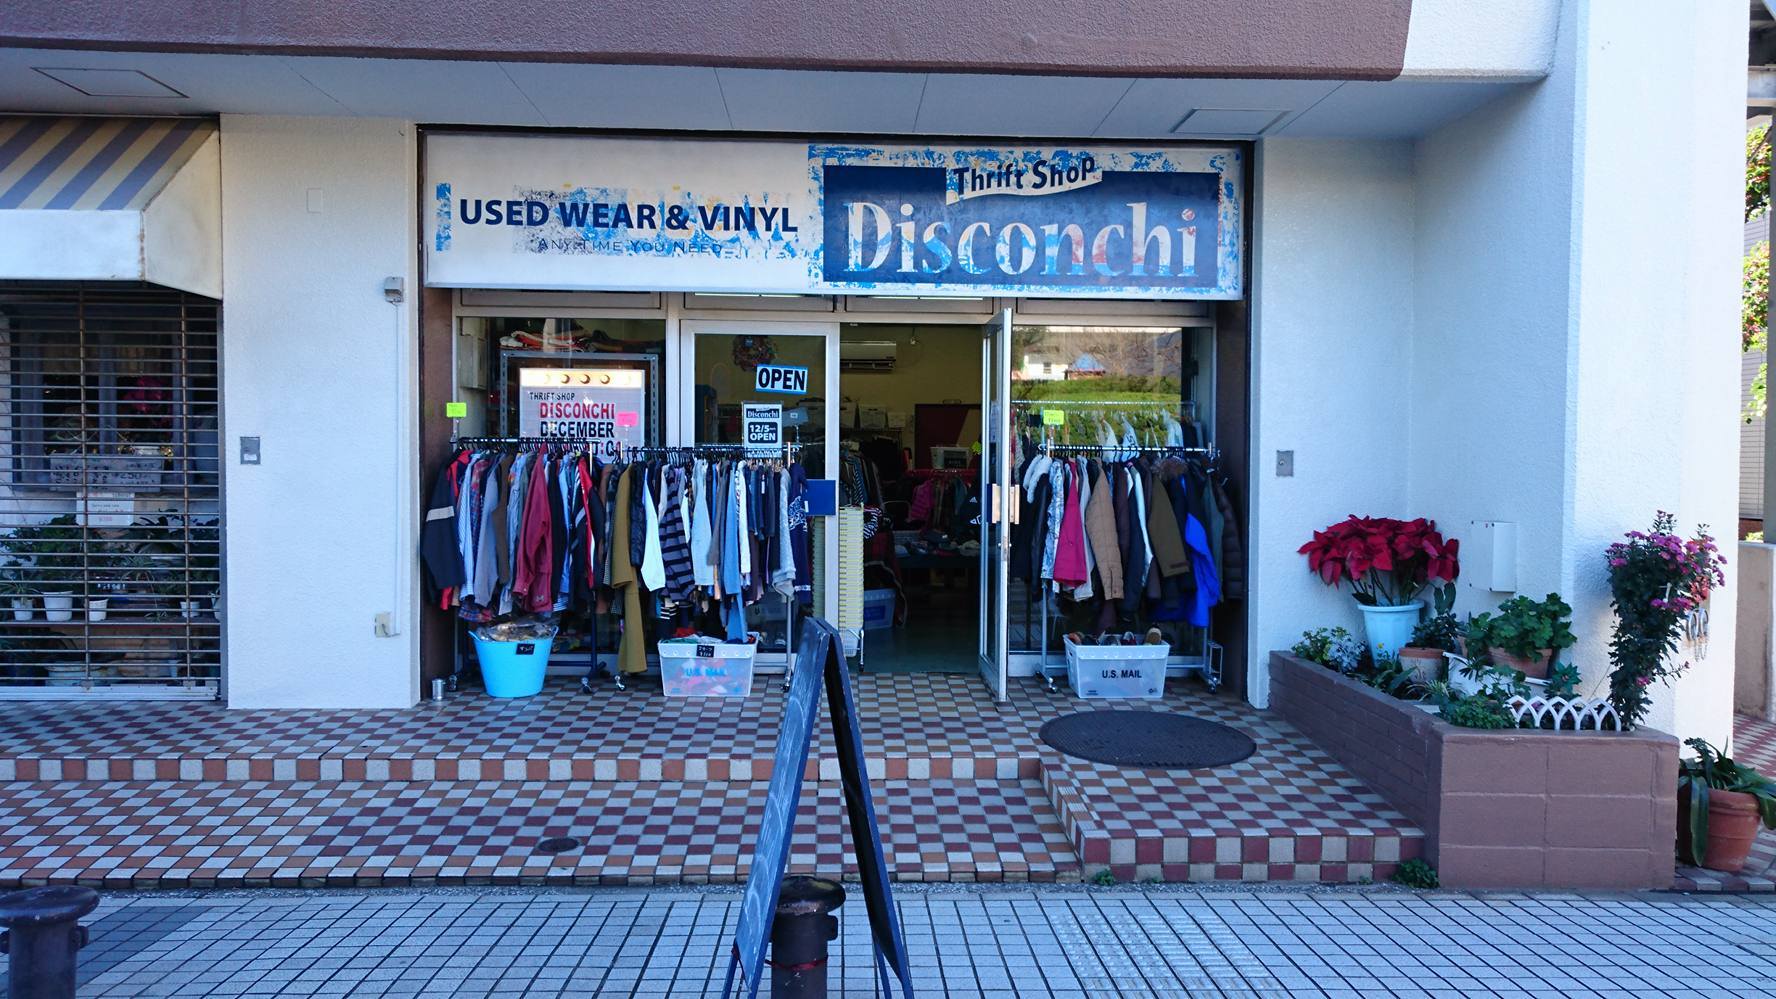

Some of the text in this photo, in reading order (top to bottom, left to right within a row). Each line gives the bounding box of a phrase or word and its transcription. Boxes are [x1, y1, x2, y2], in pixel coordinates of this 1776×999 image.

[953, 156, 1095, 196] Thrift Shop
[459, 198, 799, 233] USED WEAR & VINYL
[538, 237, 722, 255] ANY TIME YOU NEED
[842, 201, 1199, 278] Disconchi
[758, 368, 805, 391] OPEN
[529, 392, 575, 401] THRIFT SHOP
[747, 410, 778, 418] Disconchi
[540, 421, 615, 438] DECEMBER
[749, 432, 776, 441] OPEN
[1102, 670, 1142, 679] U.S. MAIL
